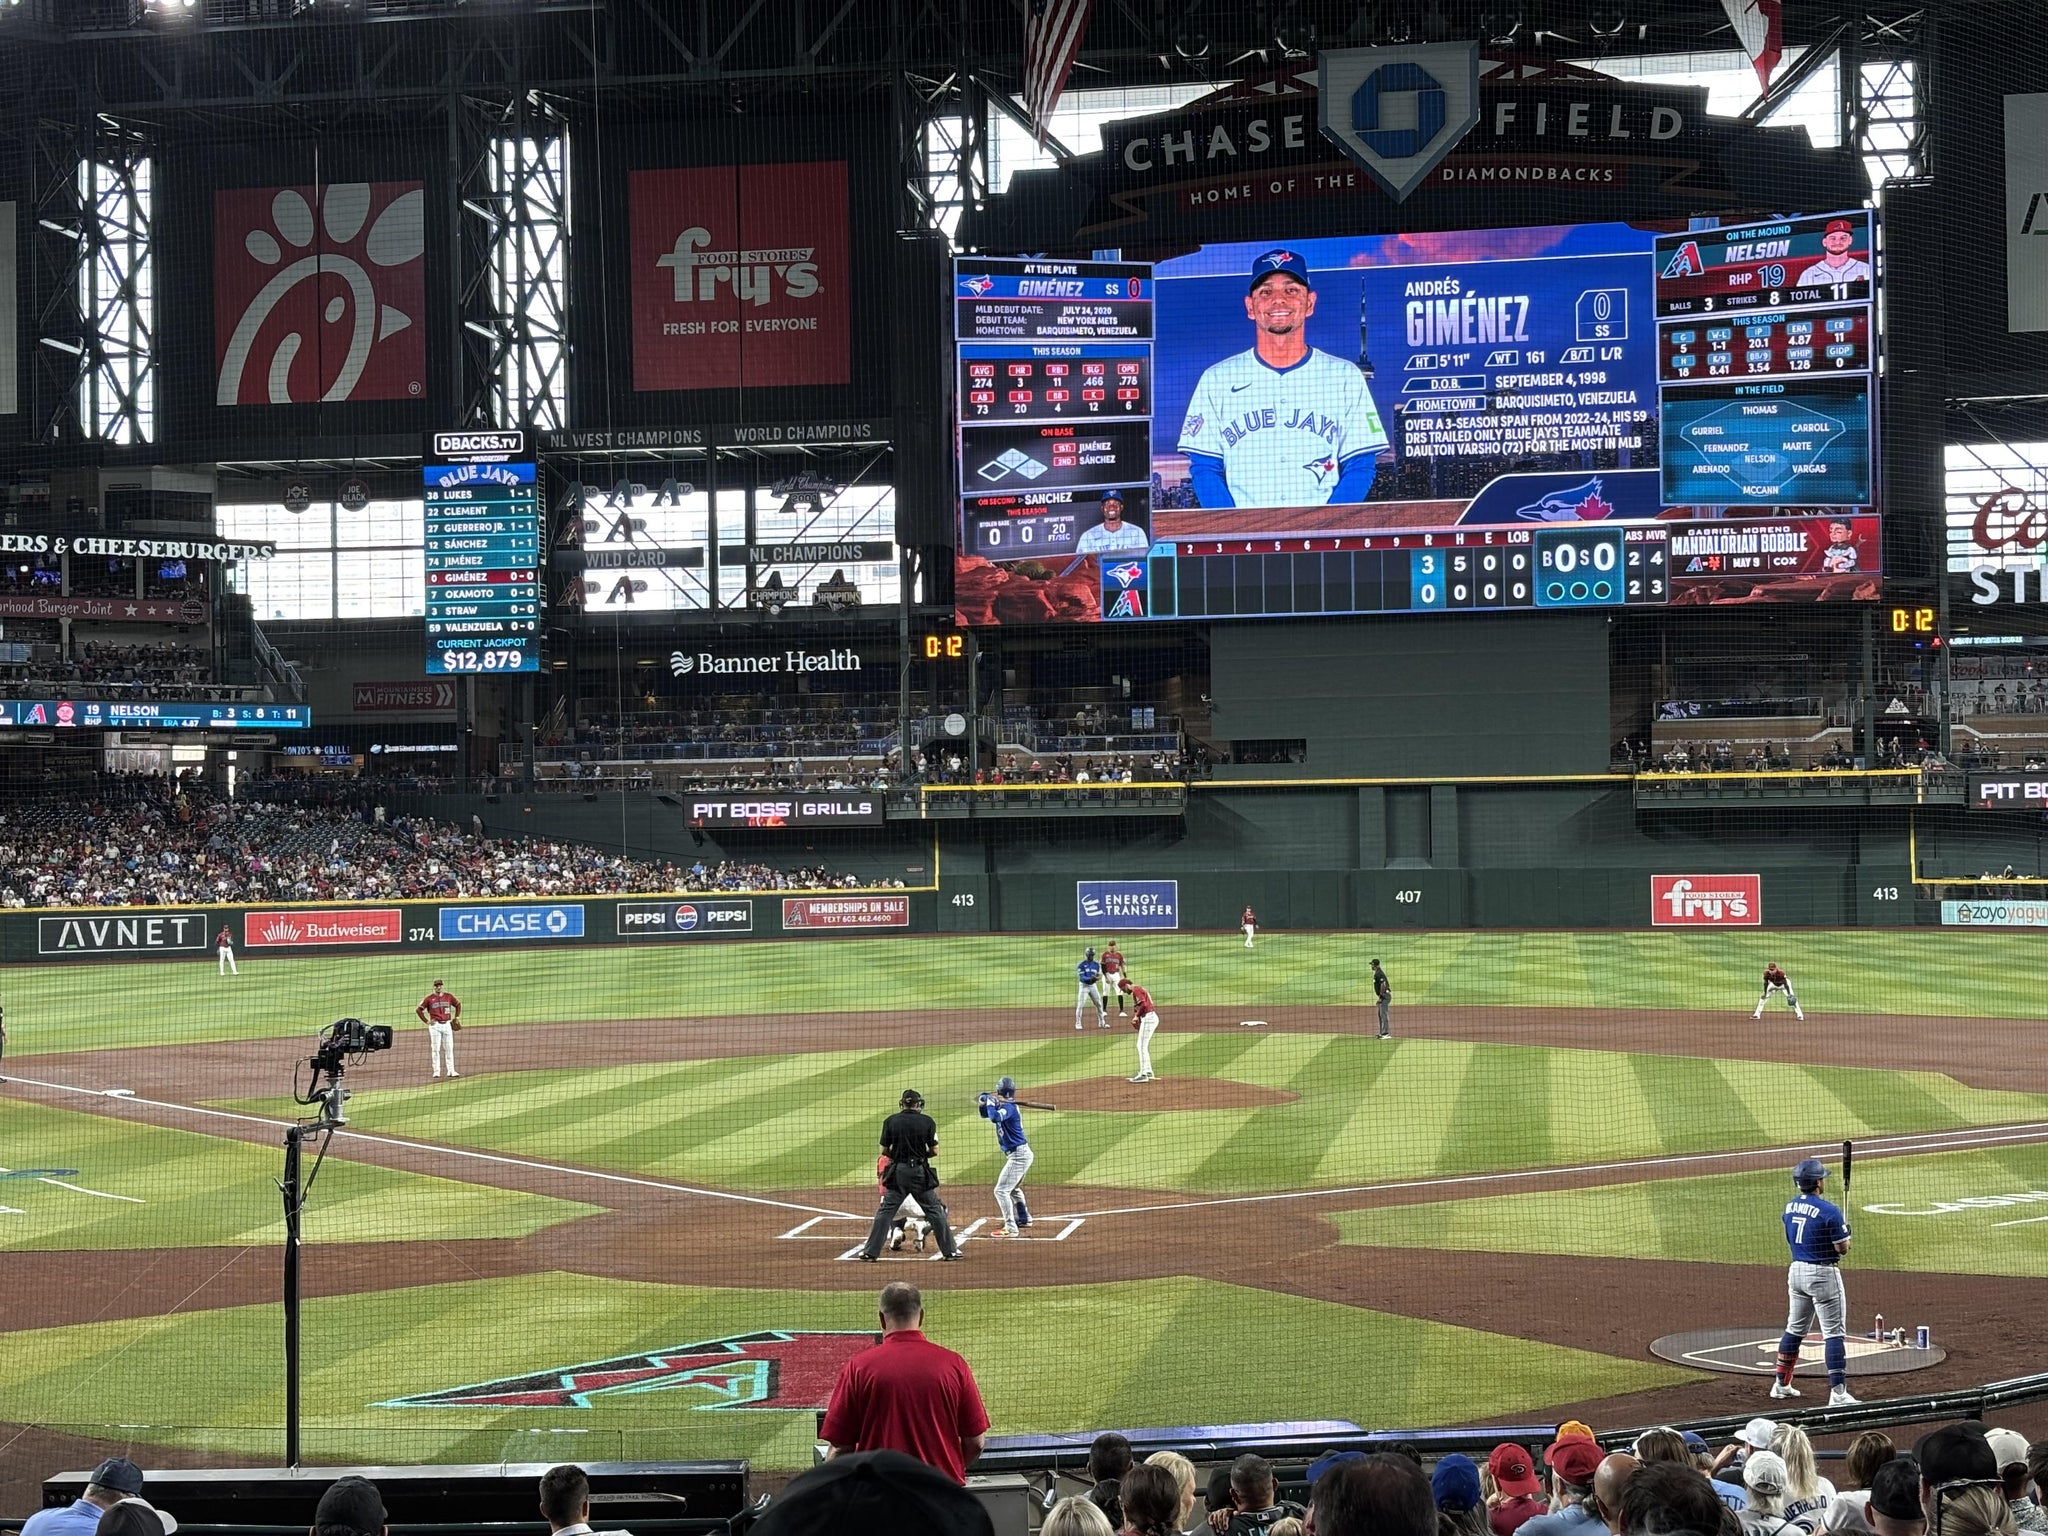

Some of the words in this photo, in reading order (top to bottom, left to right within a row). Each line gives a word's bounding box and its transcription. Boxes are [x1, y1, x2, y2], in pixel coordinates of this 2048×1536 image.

[1123, 114, 1305, 172] CHASE
[1496, 101, 1684, 141] FIELD
[1190, 185, 1254, 206] HOME
[1269, 179, 1298, 196] OF
[1314, 173, 1356, 189] THE
[1442, 167, 1614, 182] DIAMONDBACKS
[1726, 232, 1738, 241] ON
[1740, 230, 1756, 240] THE
[1758, 225, 1791, 238] MOUND
[697, 253, 739, 264] FOOD
[748, 250, 808, 262] STORES
[1725, 239, 1790, 263] NELSON
[656, 227, 819, 307] fry's
[1024, 265, 1035, 273] AT
[1037, 265, 1052, 274] THE
[1053, 266, 1077, 275] PLATE
[1729, 273, 1752, 286] RHP
[1758, 263, 1786, 288] 19
[1018, 279, 1084, 297] GIMÉNEZ
[1106, 284, 1119, 295] SS
[1128, 277, 1141, 299] 0
[1405, 276, 1460, 296] ANDRÉS
[1670, 302, 1691, 311] BALLS
[1704, 298, 1713, 312] 3
[1727, 295, 1757, 306] STRIKES
[1769, 291, 1780, 305] 8
[1790, 290, 1821, 301] TOTAL
[1830, 283, 1847, 300] 11
[1406, 290, 1529, 347] GIMÉNEZ
[663, 322, 705, 336] FRESH
[711, 321, 739, 333] FOR
[746, 317, 817, 332] EVERYONE
[976, 327, 1025, 335] HOMETOWN:
[1037, 327, 1095, 336] BARQUISIMETO,
[1097, 327, 1137, 335] VENEZUELA
[1431, 378, 1461, 389] D.O.B.
[1496, 373, 1563, 388] SEPTEMBER
[1565, 373, 1577, 387] 4,
[1578, 372, 1606, 385] 1998
[1416, 399, 1476, 410] HOMETOWN
[1496, 393, 1576, 410] BARQUISIMETO,
[1578, 391, 1636, 405] VENEZUELA
[1742, 405, 1778, 415] THOMAS
[1222, 408, 1276, 447] BLUE
[1285, 409, 1340, 445] JAYS
[1405, 419, 1434, 431] OVER
[1435, 418, 1445, 429] A
[1446, 417, 1498, 429] 3-SEASON
[1500, 416, 1529, 427] SPAN
[1531, 415, 1562, 426] FROM
[1564, 413, 1611, 426] 2022-24,
[1613, 412, 1631, 423] HIS
[1633, 411, 1647, 422] 59
[734, 427, 782, 442] WORLD
[786, 424, 871, 440] CHAMPIONS
[1055, 428, 1074, 436] BASE
[1405, 432, 1427, 444] DRS
[1429, 430, 1472, 443] TRAILED
[1473, 429, 1504, 441] ONLY
[1505, 428, 1531, 440] BLUE
[1533, 427, 1559, 441] JAYS
[1561, 424, 1621, 438] TEAMMATE
[1691, 426, 1724, 436] GURRIEL
[1791, 423, 1829, 433] CARROLL
[440, 436, 517, 450] DBACKS.TV
[550, 434, 568, 448] NL
[571, 433, 612, 446] WEST
[617, 430, 702, 445] CHAMPIONS
[1078, 441, 1111, 454] JIMÉNEZ
[1405, 444, 1455, 457] DAULTON
[1457, 443, 1500, 455] VARSHO
[1502, 442, 1524, 455] (72)
[1525, 441, 1548, 453] FOR
[1549, 440, 1569, 452] THE
[1571, 438, 1603, 451] MOST
[1605, 438, 1616, 449] IN
[1617, 436, 1642, 448] MLB
[1704, 443, 1749, 453] FERNANDEZ
[1783, 442, 1812, 451] MARTE
[1079, 454, 1116, 464] SÁNCHEZ
[1745, 454, 1775, 463] NELSON
[439, 465, 478, 487] BLUE
[481, 465, 520, 486] JAYS
[1693, 465, 1730, 474] ARENADO
[1792, 465, 1827, 474] VARGAS
[443, 490, 472, 499] LUKES
[1743, 486, 1779, 495] MCCANN
[444, 507, 488, 515] CLEMENT
[444, 523, 493, 533] GUERRERO
[493, 523, 506, 534] JR.
[1688, 527, 1737, 536] GABRIEL
[1742, 525, 1791, 534] MORENO
[54, 538, 68, 551] &
[73, 538, 273, 560] CHEESEBURGERS
[444, 538, 488, 548] SÁNCHEZ
[1672, 534, 1757, 556] MANDALORIAN
[1761, 532, 1808, 553] BOBBLE
[444, 554, 483, 567] JIMÉNEZ
[586, 553, 622, 567] WILD
[628, 552, 666, 566] CARD
[750, 548, 768, 562] NL
[773, 545, 862, 560] CHAMPIONS
[1773, 557, 1797, 566] COX
[445, 571, 488, 582] GIMÉNEZ
[445, 589, 494, 599] OKAMOTO
[37, 599, 80, 616] Burger
[82, 600, 112, 616] Joint
[445, 606, 478, 615] STRAW
[445, 622, 503, 632] VALENZUELA
[1892, 608, 1934, 632] 0:12
[437, 639, 482, 648] CURRENT
[484, 638, 527, 648] JACKPOT
[926, 635, 962, 657] 0:12
[443, 649, 522, 672] $12,879
[697, 652, 780, 674] Banner
[785, 648, 862, 674] Health
[376, 692, 432, 705] FITNESS
[86, 705, 100, 714] 19
[110, 706, 159, 716] NELSON
[1981, 783, 2020, 799] PIT
[693, 802, 727, 819] PIT
[730, 802, 792, 818] BOSS
[803, 802, 873, 816] GRILLS
[952, 895, 974, 906] 413
[1105, 895, 1158, 905] ENERGY
[1395, 890, 1422, 904] 407
[1662, 879, 1747, 920] fry's
[1873, 887, 1899, 901] 413
[809, 903, 868, 914] MEMBERSHIPS
[870, 903, 882, 913] ON
[884, 902, 904, 912] SALE
[1106, 905, 1172, 915] TRANSFER
[457, 913, 541, 933] CHASE
[625, 913, 665, 924] PEPSI
[707, 911, 747, 922] PEPSI
[842, 915, 892, 923] 602.462.4600
[58, 917, 189, 949] AVNET
[306, 923, 388, 938] Budweiser
[409, 928, 435, 942] 374
[1792, 1217, 1806, 1244] 7
